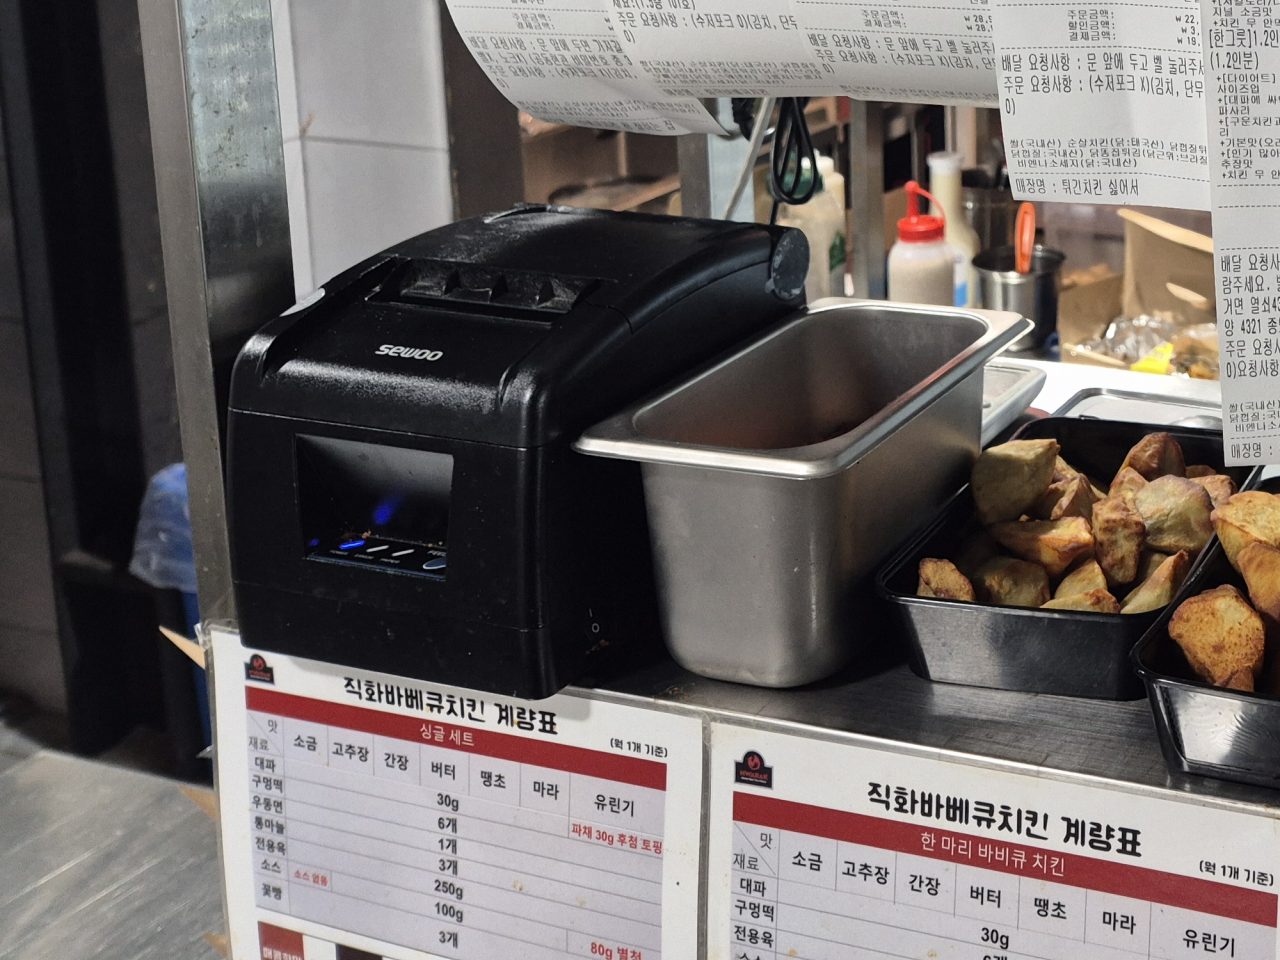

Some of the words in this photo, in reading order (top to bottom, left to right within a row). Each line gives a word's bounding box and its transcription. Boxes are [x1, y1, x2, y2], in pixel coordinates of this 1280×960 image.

[375, 343, 443, 362] sewoo
[1231, 443, 1261, 458] 매장명
[344, 676, 486, 724] 직화바베큐치킨
[494, 702, 559, 735] 계량표
[268, 720, 278, 733] 맛
[420, 723, 445, 740] 싱글
[449, 730, 475, 747] 세트
[249, 736, 269, 751] 재료
[627, 741, 641, 754] 1개
[645, 744, 668, 758] 기준)
[293, 735, 318, 752] 소금
[332, 742, 369, 762] 고추장
[384, 752, 409, 771] 간장
[431, 761, 456, 780] 버터
[481, 770, 506, 789] 땡초
[533, 781, 559, 800] 마라
[594, 794, 635, 817] 유린기
[252, 775, 283, 793] 구멍떡
[437, 818, 458, 834] 6개
[254, 756, 276, 773] 대파
[437, 793, 459, 812] 30g
[572, 824, 593, 839] 파채
[595, 829, 614, 845] 30g
[617, 834, 638, 850] 후첨
[641, 840, 663, 854] 토핑
[252, 795, 283, 814] 우동면
[438, 838, 458, 855] 1개
[867, 781, 1049, 841] 직화바베큐치킨
[1061, 816, 1142, 858] 계량표
[254, 816, 285, 835] 통마늘
[438, 859, 458, 876] 3개
[760, 833, 772, 850] 맛
[733, 852, 760, 872] 재료
[921, 832, 936, 852] 한
[941, 836, 973, 859] 마리
[978, 842, 1028, 869] 바비큐
[1032, 856, 1065, 878] 치킨
[1221, 864, 1240, 880] 1개
[1244, 868, 1274, 887] 기준)
[261, 859, 282, 874] 소스
[434, 902, 464, 923] 100g
[434, 879, 464, 900] 250g
[734, 900, 775, 922] 구멍떡
[740, 878, 767, 897] 대파
[981, 927, 1010, 950] 30g
[791, 851, 823, 872] 소금
[842, 860, 890, 885] 고추장
[908, 874, 941, 897] 간장
[970, 886, 1001, 908] 버터
[1034, 897, 1068, 921] 땡초
[1103, 911, 1137, 935] 마라
[1182, 929, 1236, 958] 유린기
[439, 931, 459, 949] 3개
[734, 925, 774, 948] 전용육
